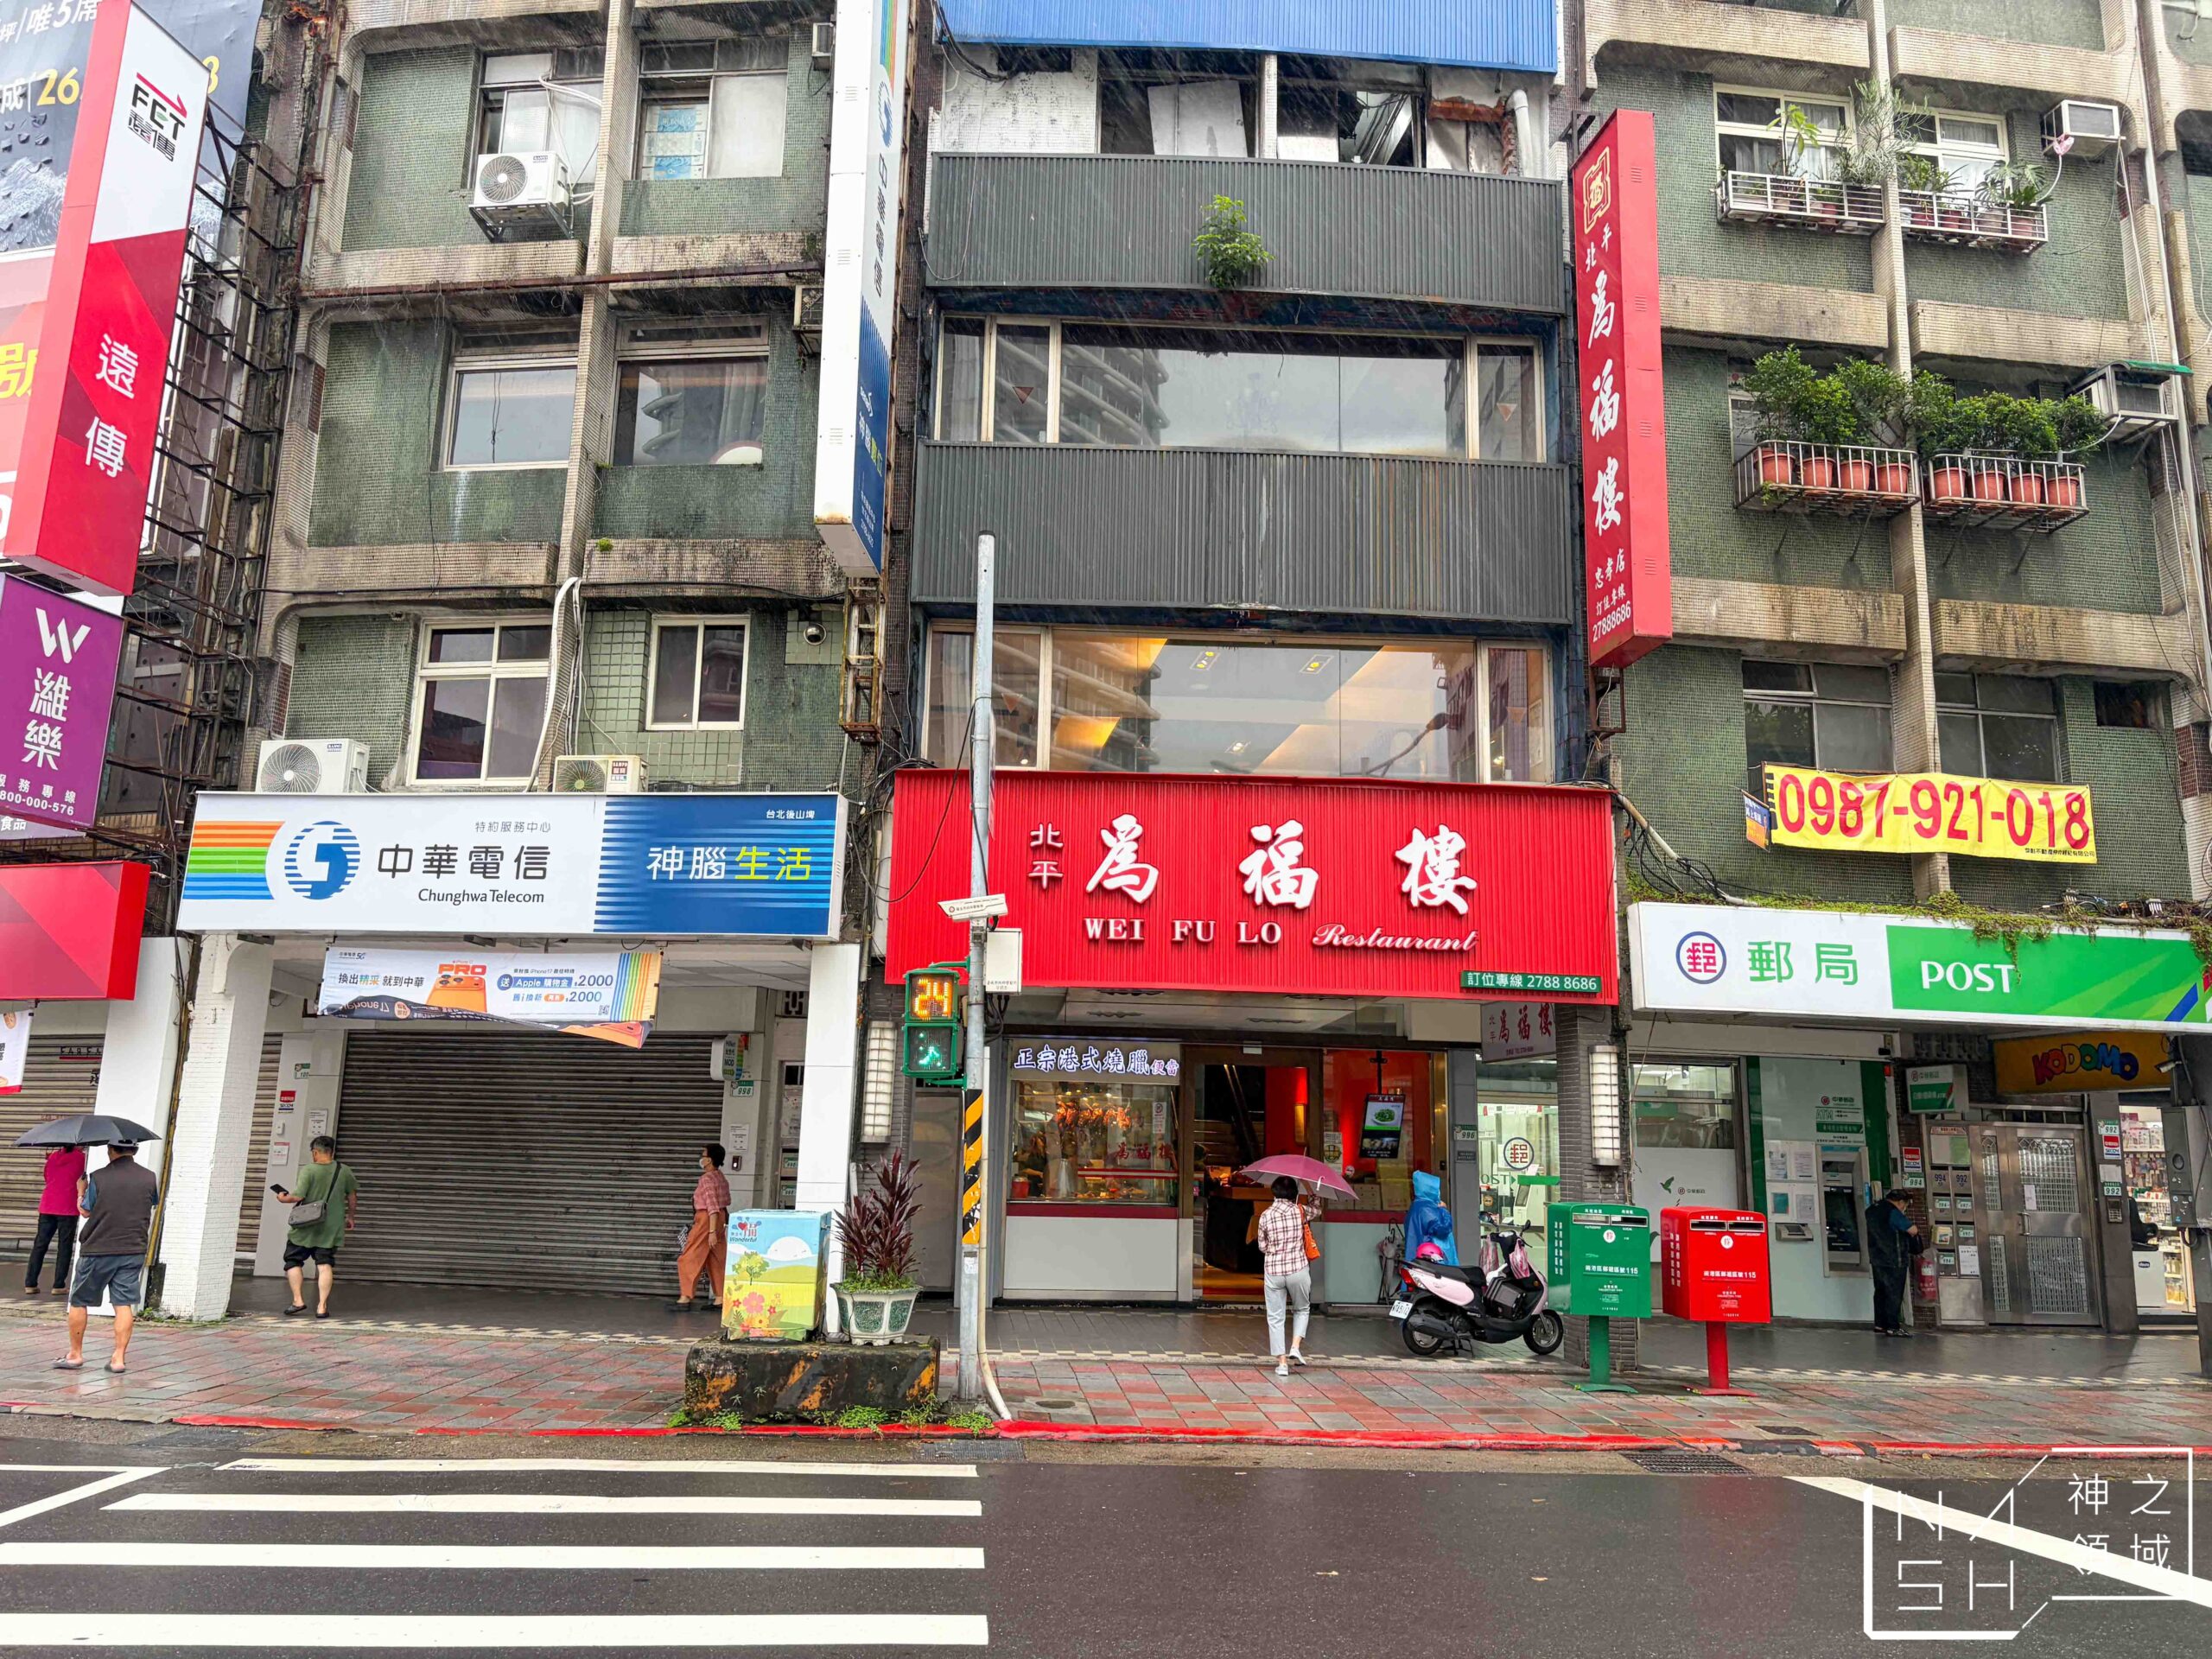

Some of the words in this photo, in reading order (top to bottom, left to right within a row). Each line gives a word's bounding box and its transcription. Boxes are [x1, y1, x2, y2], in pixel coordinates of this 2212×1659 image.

[86, 334, 138, 478] 遠傳
[1592, 601, 1631, 643] 27888686
[475, 821, 551, 833] 特約服務中心
[766, 810, 816, 820] 台北後山埤
[1778, 773, 2090, 850] 0987-921-018
[378, 843, 551, 880] 中華電信
[646, 845, 812, 880] 神腦生活
[1028, 823, 1065, 890] 北平
[418, 887, 487, 906] Chunghwa
[489, 889, 544, 903] Telecom
[1084, 918, 1145, 941] WEI
[1172, 919, 1217, 944] FU
[1237, 921, 1282, 945] LO
[1313, 923, 1478, 952] Restaurant
[438, 964, 487, 975] PRO
[1748, 940, 1858, 986] 郵局
[1921, 960, 2013, 994] POST
[382, 976, 425, 988] 就到中華
[500, 977, 512, 988] 送
[516, 978, 541, 988] Apple
[915, 978, 950, 1016] 24
[1467, 972, 1522, 989] 訂位專線
[1527, 974, 1560, 989] 2788
[1564, 976, 1597, 991] 8686
[2033, 1043, 2139, 1086] KODOMO
